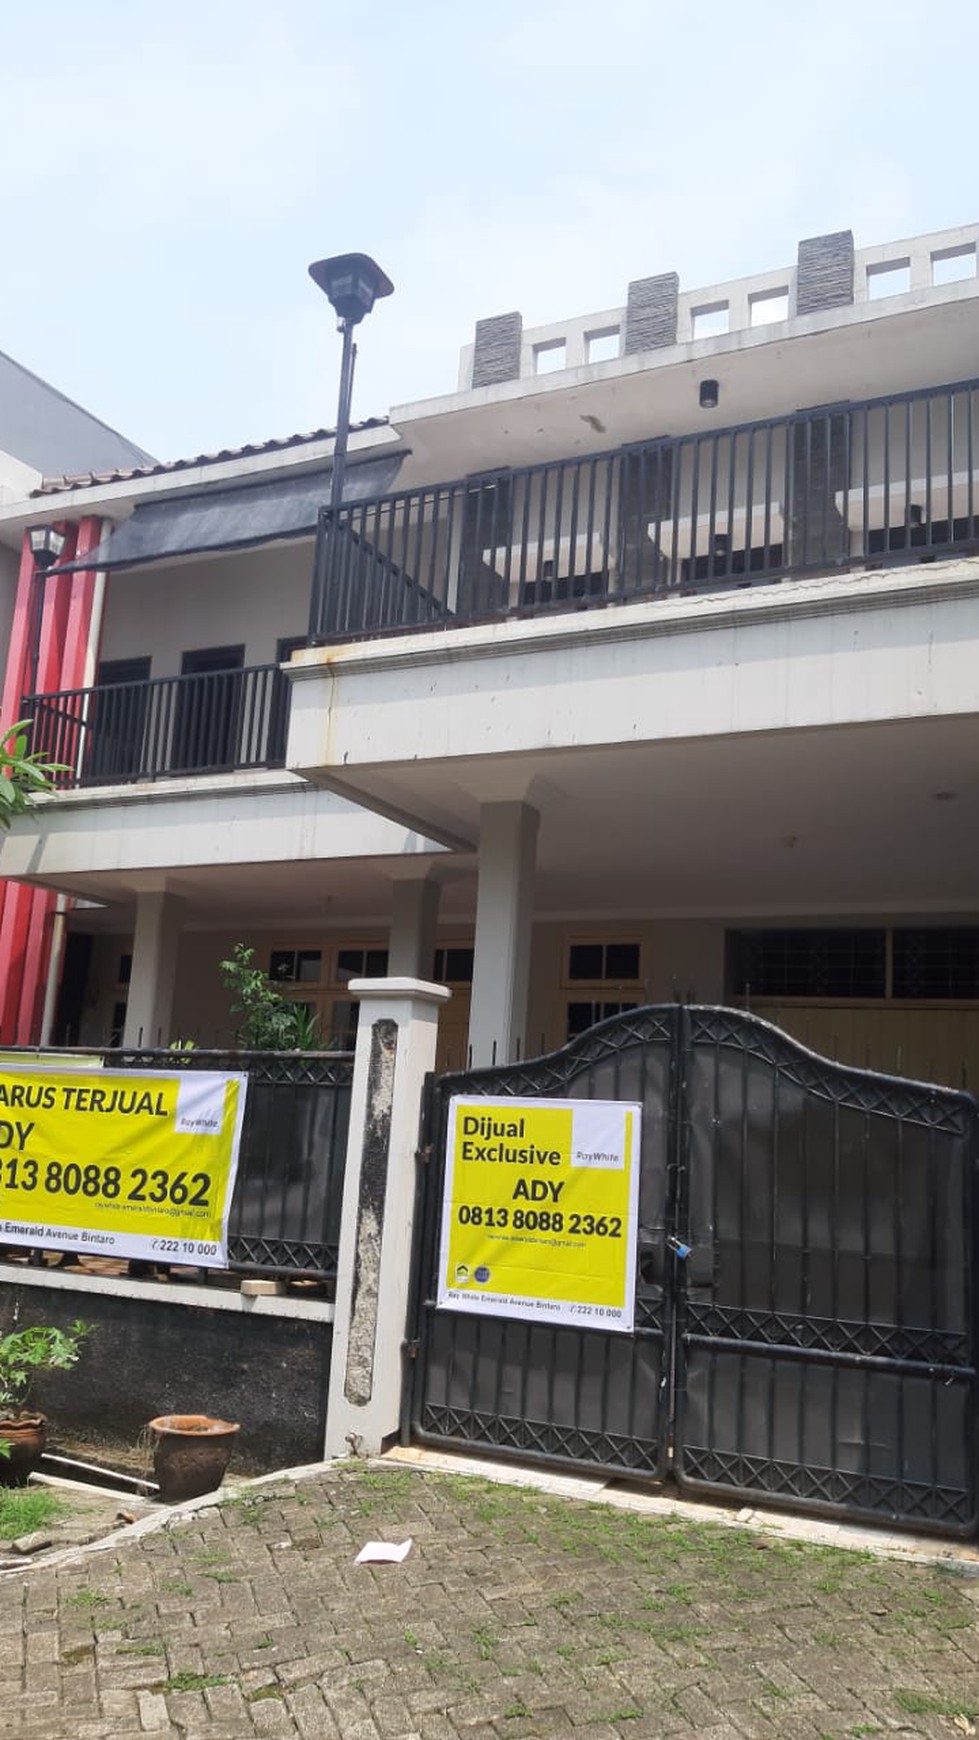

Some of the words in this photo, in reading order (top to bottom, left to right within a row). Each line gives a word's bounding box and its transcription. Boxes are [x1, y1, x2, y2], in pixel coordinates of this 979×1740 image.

[62, 1087, 168, 1116] TERJUAL
[463, 1116, 525, 1141] Dijual
[462, 1141, 562, 1166] Exclusive
[0, 1158, 39, 1192] 13
[45, 1161, 121, 1199] 8088
[127, 1168, 211, 1207] 2362
[512, 1178, 565, 1203] ADY
[4, 1222, 44, 1236] Emerald
[46, 1228, 79, 1240] Avenue
[81, 1232, 115, 1245] Bintaro
[458, 1205, 509, 1228] 0813
[512, 1210, 564, 1233] 8088
[568, 1213, 622, 1238] 2362
[160, 1239, 179, 1252] 222
[183, 1242, 194, 1253] 10
[197, 1244, 217, 1256] 000
[577, 1306, 593, 1315] 222
[595, 1308, 605, 1317] 10
[606, 1310, 622, 1319] 000
